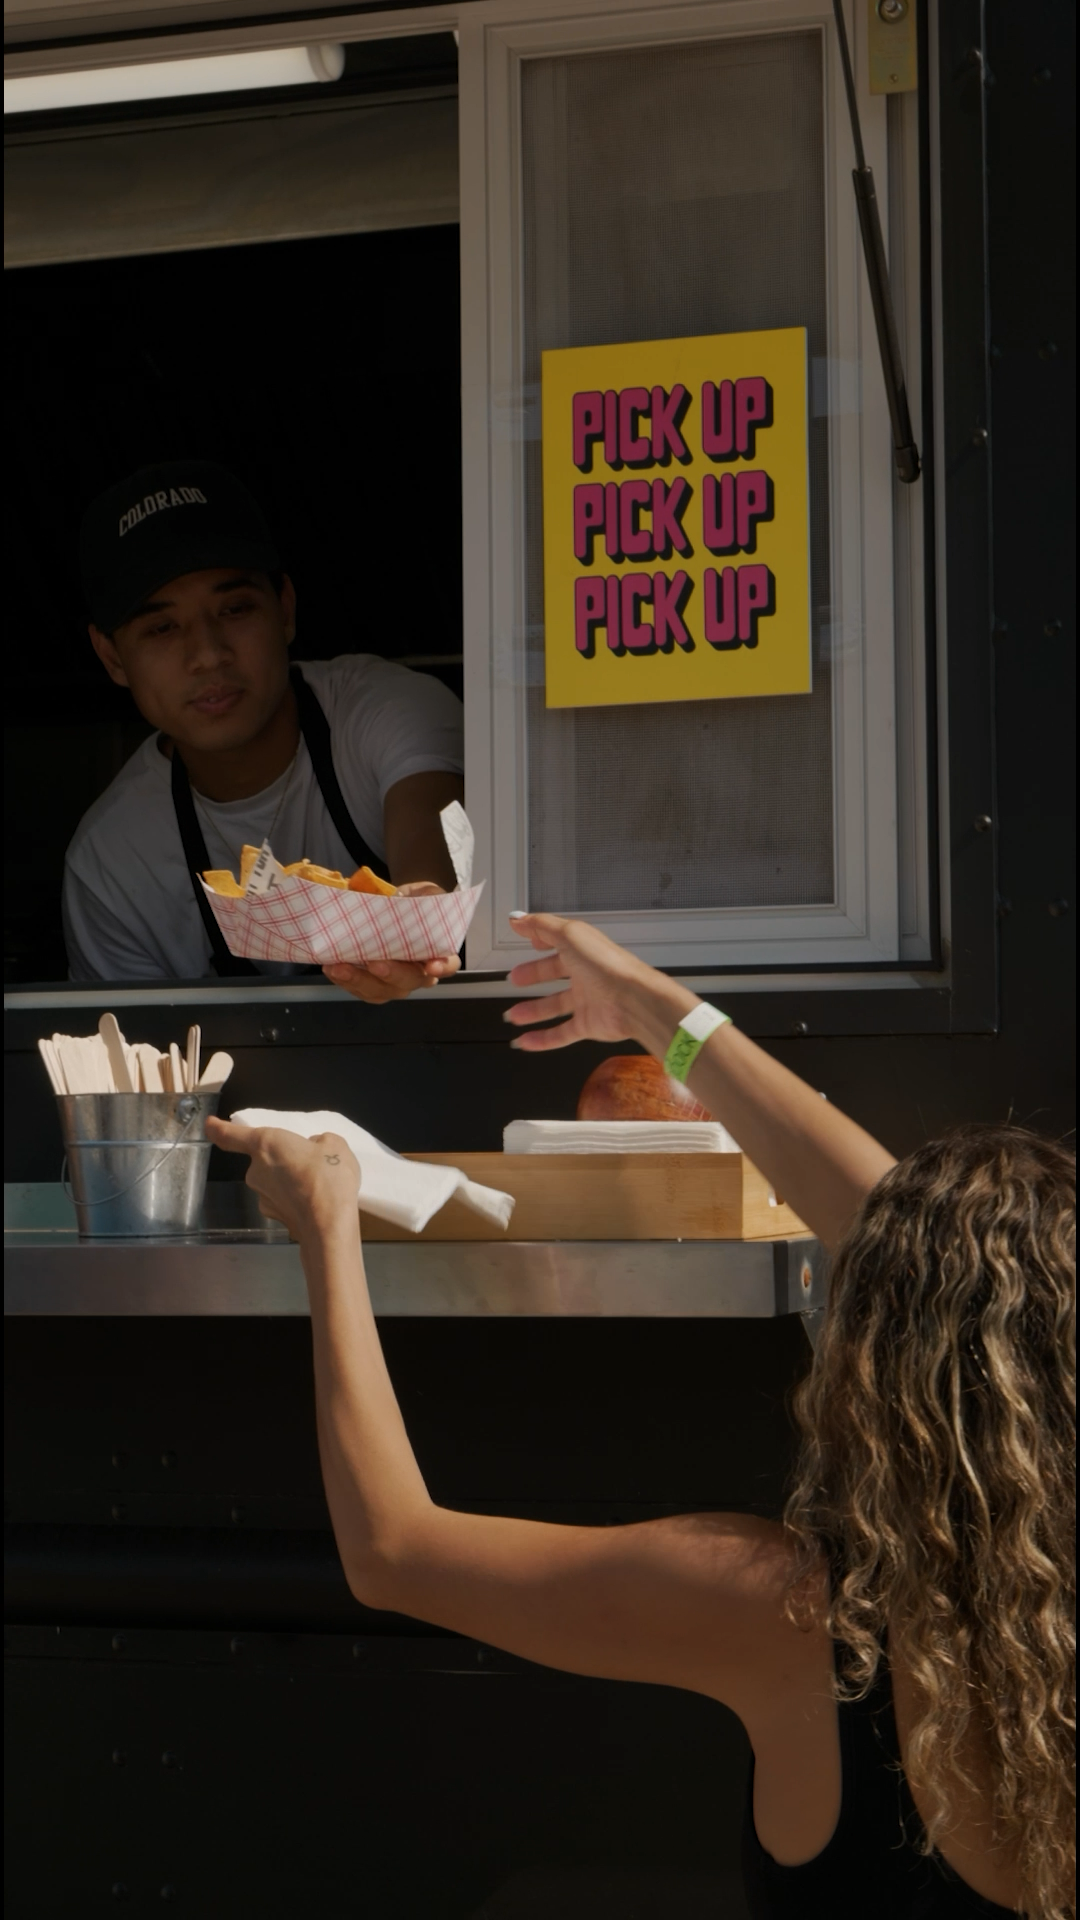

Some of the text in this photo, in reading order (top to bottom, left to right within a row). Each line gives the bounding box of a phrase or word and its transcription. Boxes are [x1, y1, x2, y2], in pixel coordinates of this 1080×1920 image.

[572, 376, 774, 474] PICK UP
[118, 486, 209, 537] COLORADO
[573, 469, 775, 566] PICK UP
[574, 563, 776, 659] PICK UP
